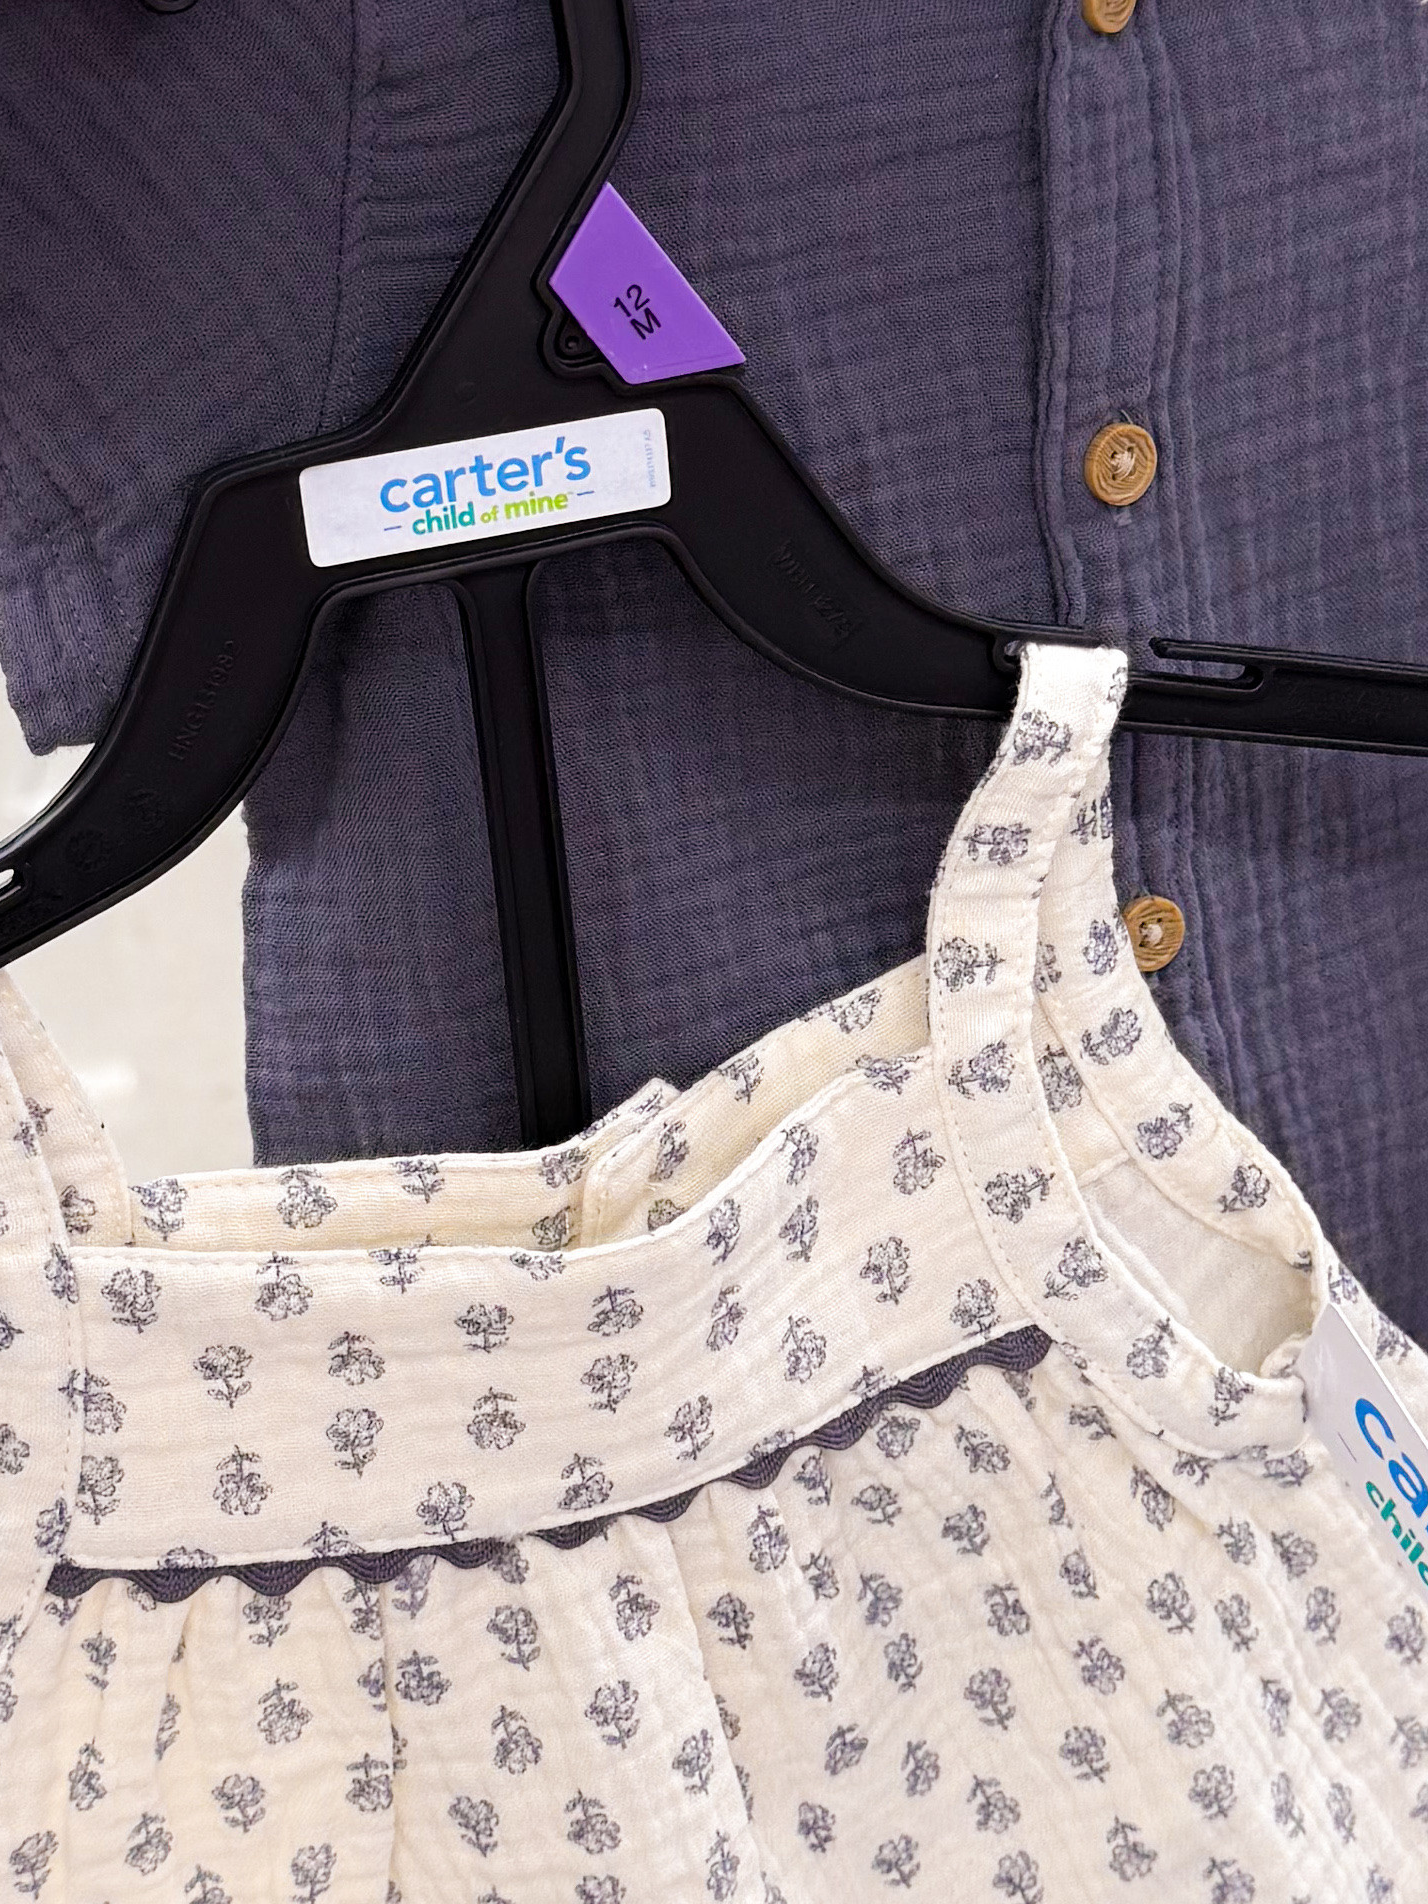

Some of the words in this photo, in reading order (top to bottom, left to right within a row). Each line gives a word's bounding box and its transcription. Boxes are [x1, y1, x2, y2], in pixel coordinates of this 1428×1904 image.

[613, 283, 651, 319] 12
[629, 309, 663, 341] M
[380, 435, 592, 513] carter's
[412, 500, 476, 536] child
[480, 504, 500, 525] of
[504, 490, 569, 520] mine
